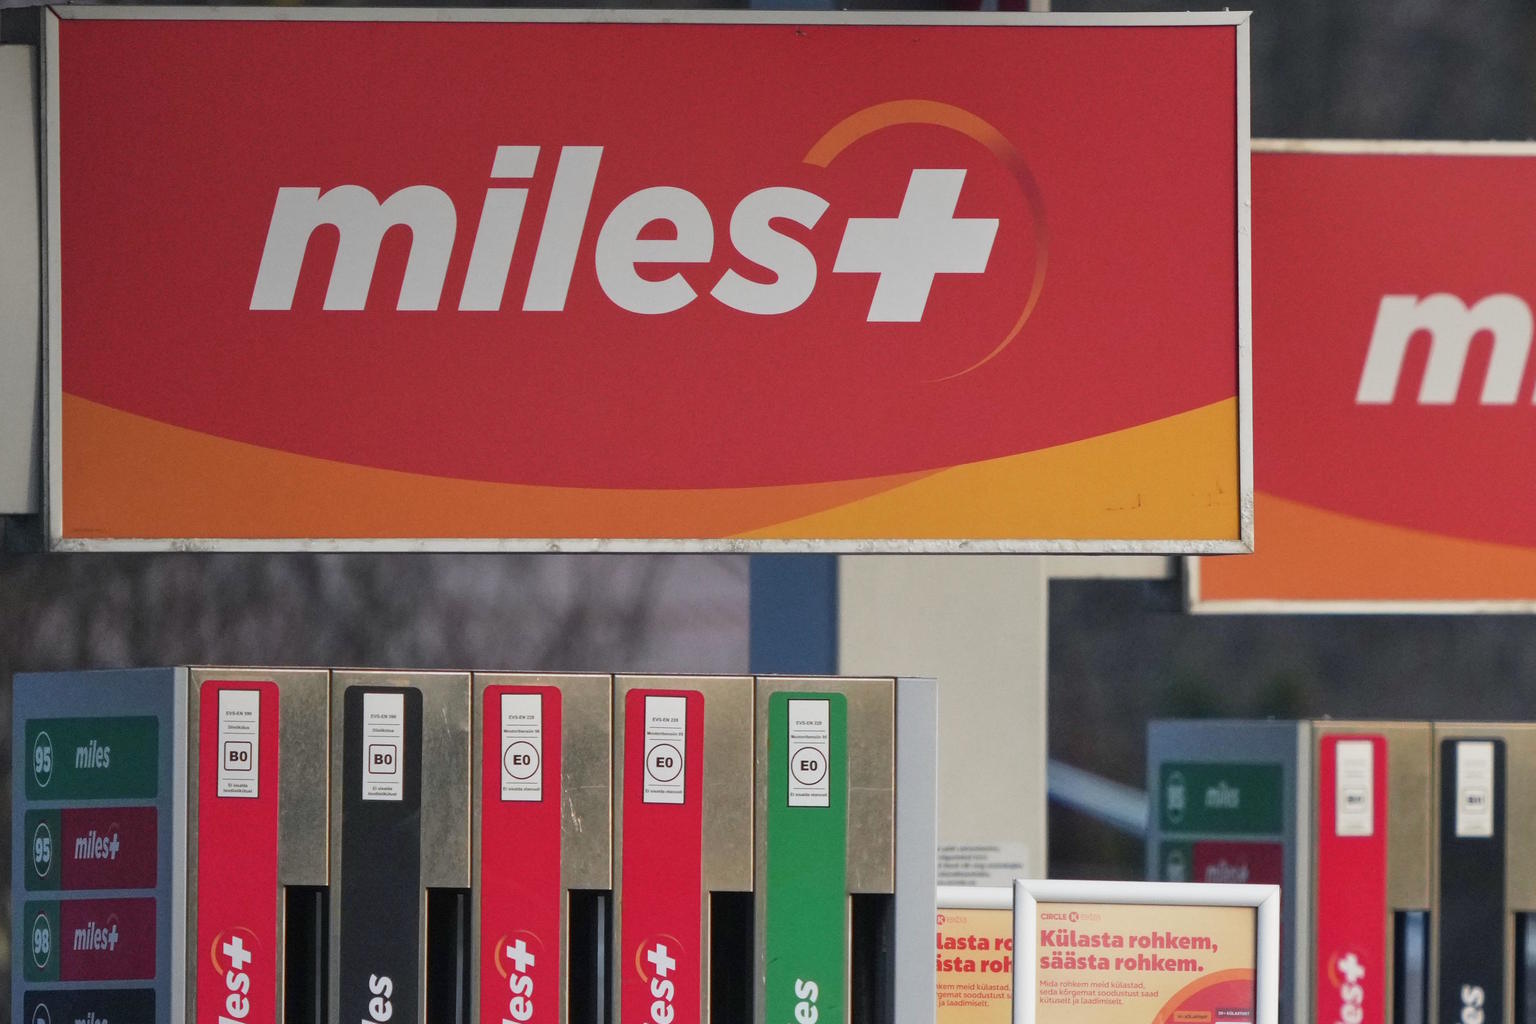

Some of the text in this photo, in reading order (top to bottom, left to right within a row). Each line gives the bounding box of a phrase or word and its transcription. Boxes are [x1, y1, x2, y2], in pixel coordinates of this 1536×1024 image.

[249, 145, 1000, 322] miles+
[35, 740, 111, 773] 95 miles
[35, 837, 50, 863] 95
[1041, 913, 1067, 921] CIRCLE
[34, 928, 49, 954] 98
[936, 932, 990, 951] lasta
[1040, 929, 1218, 953] Külasta rohkem,
[1040, 951, 1204, 972] säästa rohkem.
[1040, 980, 1059, 988] Mida
[1040, 988, 1058, 996] seda
[1141, 990, 1159, 998] saad
